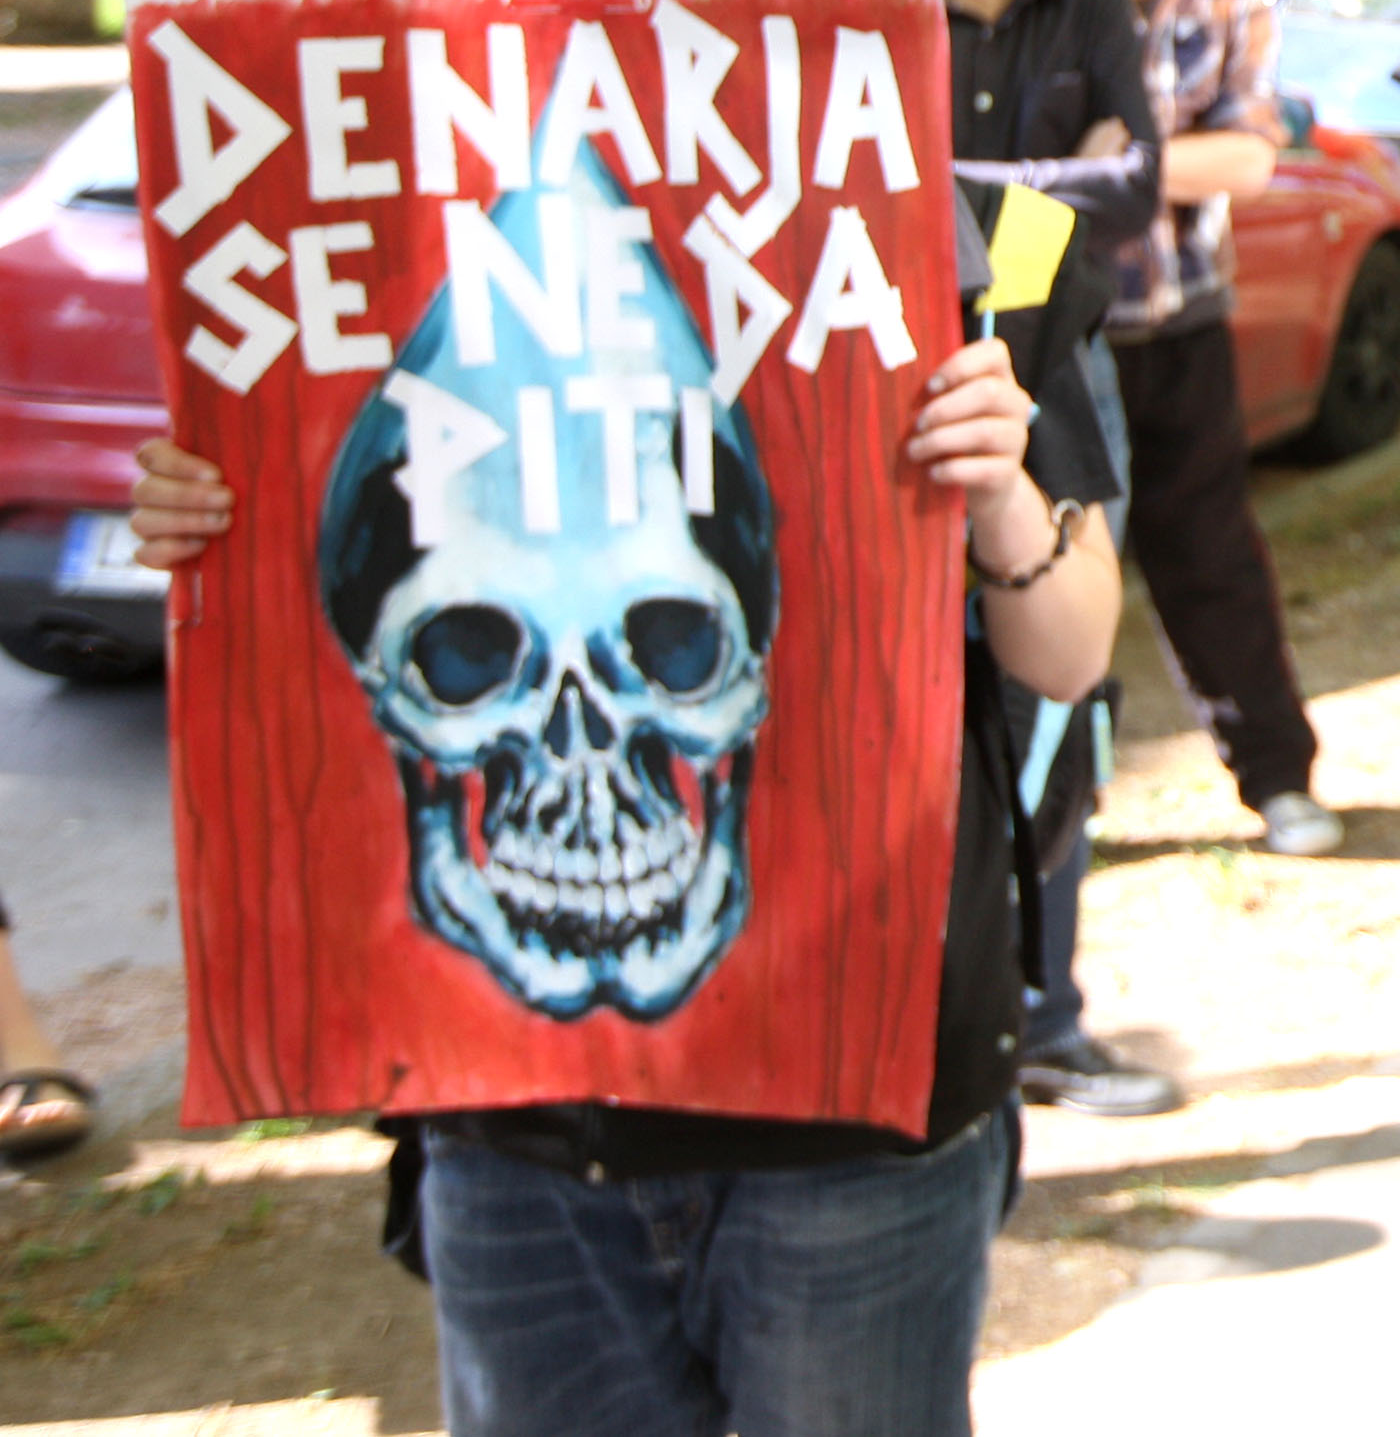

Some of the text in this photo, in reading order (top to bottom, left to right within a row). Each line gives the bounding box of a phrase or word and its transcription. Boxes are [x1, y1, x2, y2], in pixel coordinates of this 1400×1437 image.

[184, 193, 917, 405] SE NE DA
[381, 368, 714, 546] PITI
